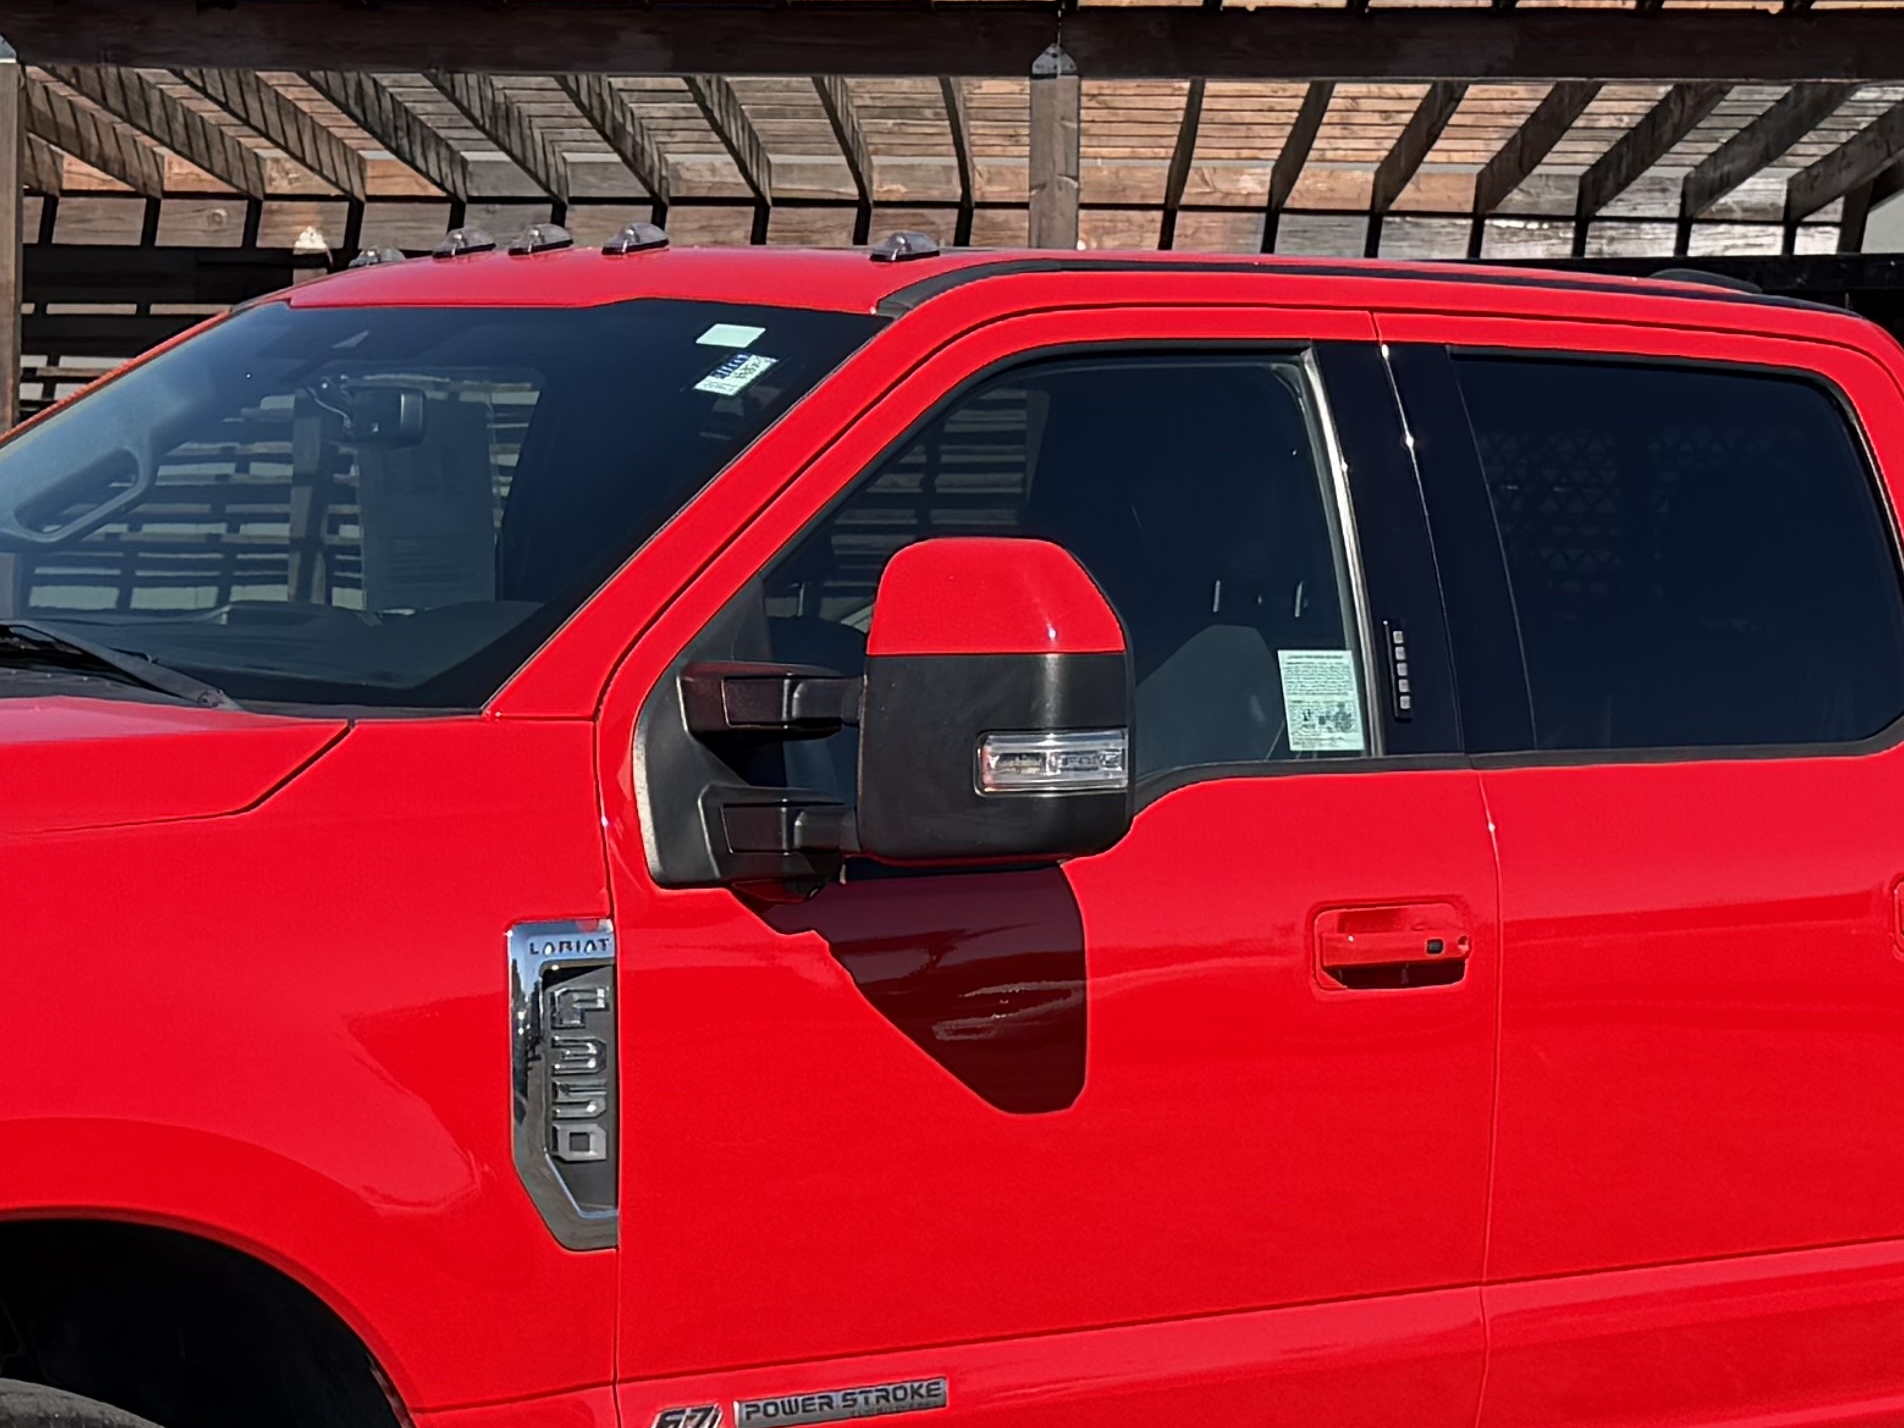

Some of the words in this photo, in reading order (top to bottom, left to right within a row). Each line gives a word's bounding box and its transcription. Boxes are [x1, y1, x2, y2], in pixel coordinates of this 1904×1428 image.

[528, 937, 610, 957] LARIAT
[745, 1395, 834, 1421] POWER
[841, 1380, 943, 1408] STROKE
